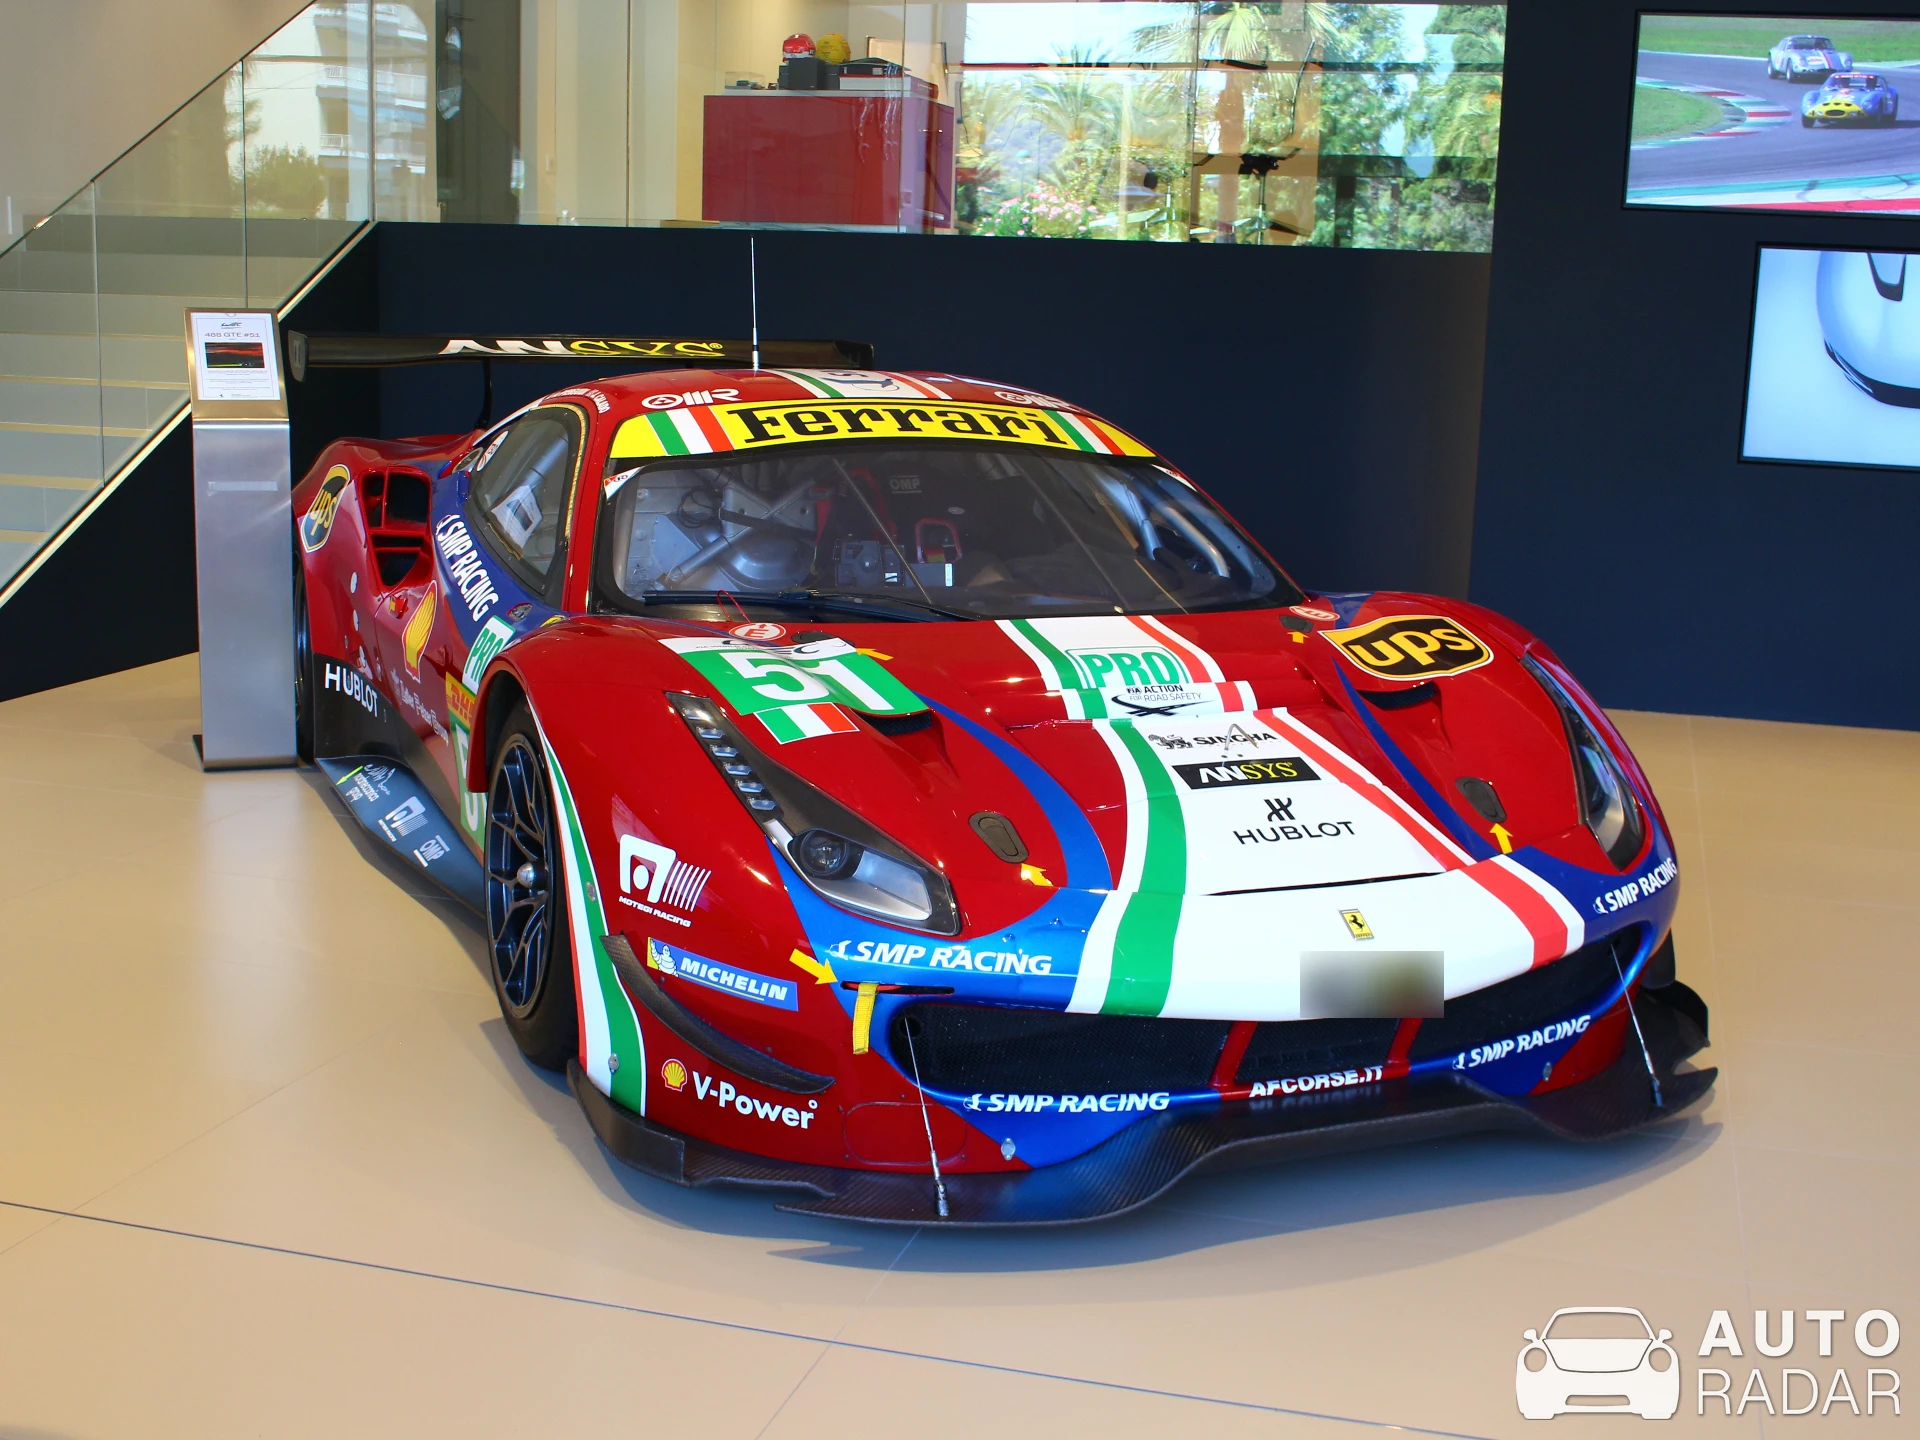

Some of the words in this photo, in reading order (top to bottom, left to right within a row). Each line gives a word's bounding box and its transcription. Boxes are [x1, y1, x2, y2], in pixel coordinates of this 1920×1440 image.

[728, 407, 1069, 445] Ferrari
[890, 479, 921, 490] OMP
[309, 488, 338, 536] ups
[437, 520, 473, 560] SMP
[450, 552, 500, 623] RACING
[464, 627, 505, 685] PRO
[1348, 628, 1476, 667] ups
[719, 652, 895, 711] 51
[1077, 651, 1180, 688] PRO
[325, 662, 378, 717] HUBLOT
[1126, 686, 1142, 694] FIA
[1144, 684, 1184, 694] ACTION
[1144, 693, 1168, 702] ROAD
[1170, 692, 1202, 701] SAFETY
[1193, 732, 1278, 746] SINGHA
[1200, 761, 1298, 784] ANSYS
[419, 839, 445, 861] OMP
[1232, 820, 1356, 845] HUBLOT
[1604, 882, 1640, 912] SMP
[1637, 857, 1678, 897] RACING
[618, 896, 653, 914] MOTEGI
[653, 909, 692, 928] RACING
[853, 941, 927, 966] SMP
[929, 947, 1052, 975] RACING
[680, 957, 788, 1001] MICHELIN
[1469, 1039, 1516, 1068] SMP
[1517, 1015, 1592, 1054] RACING
[1249, 1066, 1384, 1098] AFCORSE.IT
[986, 1094, 1053, 1112] SMP
[1056, 1092, 1170, 1112] RACING
